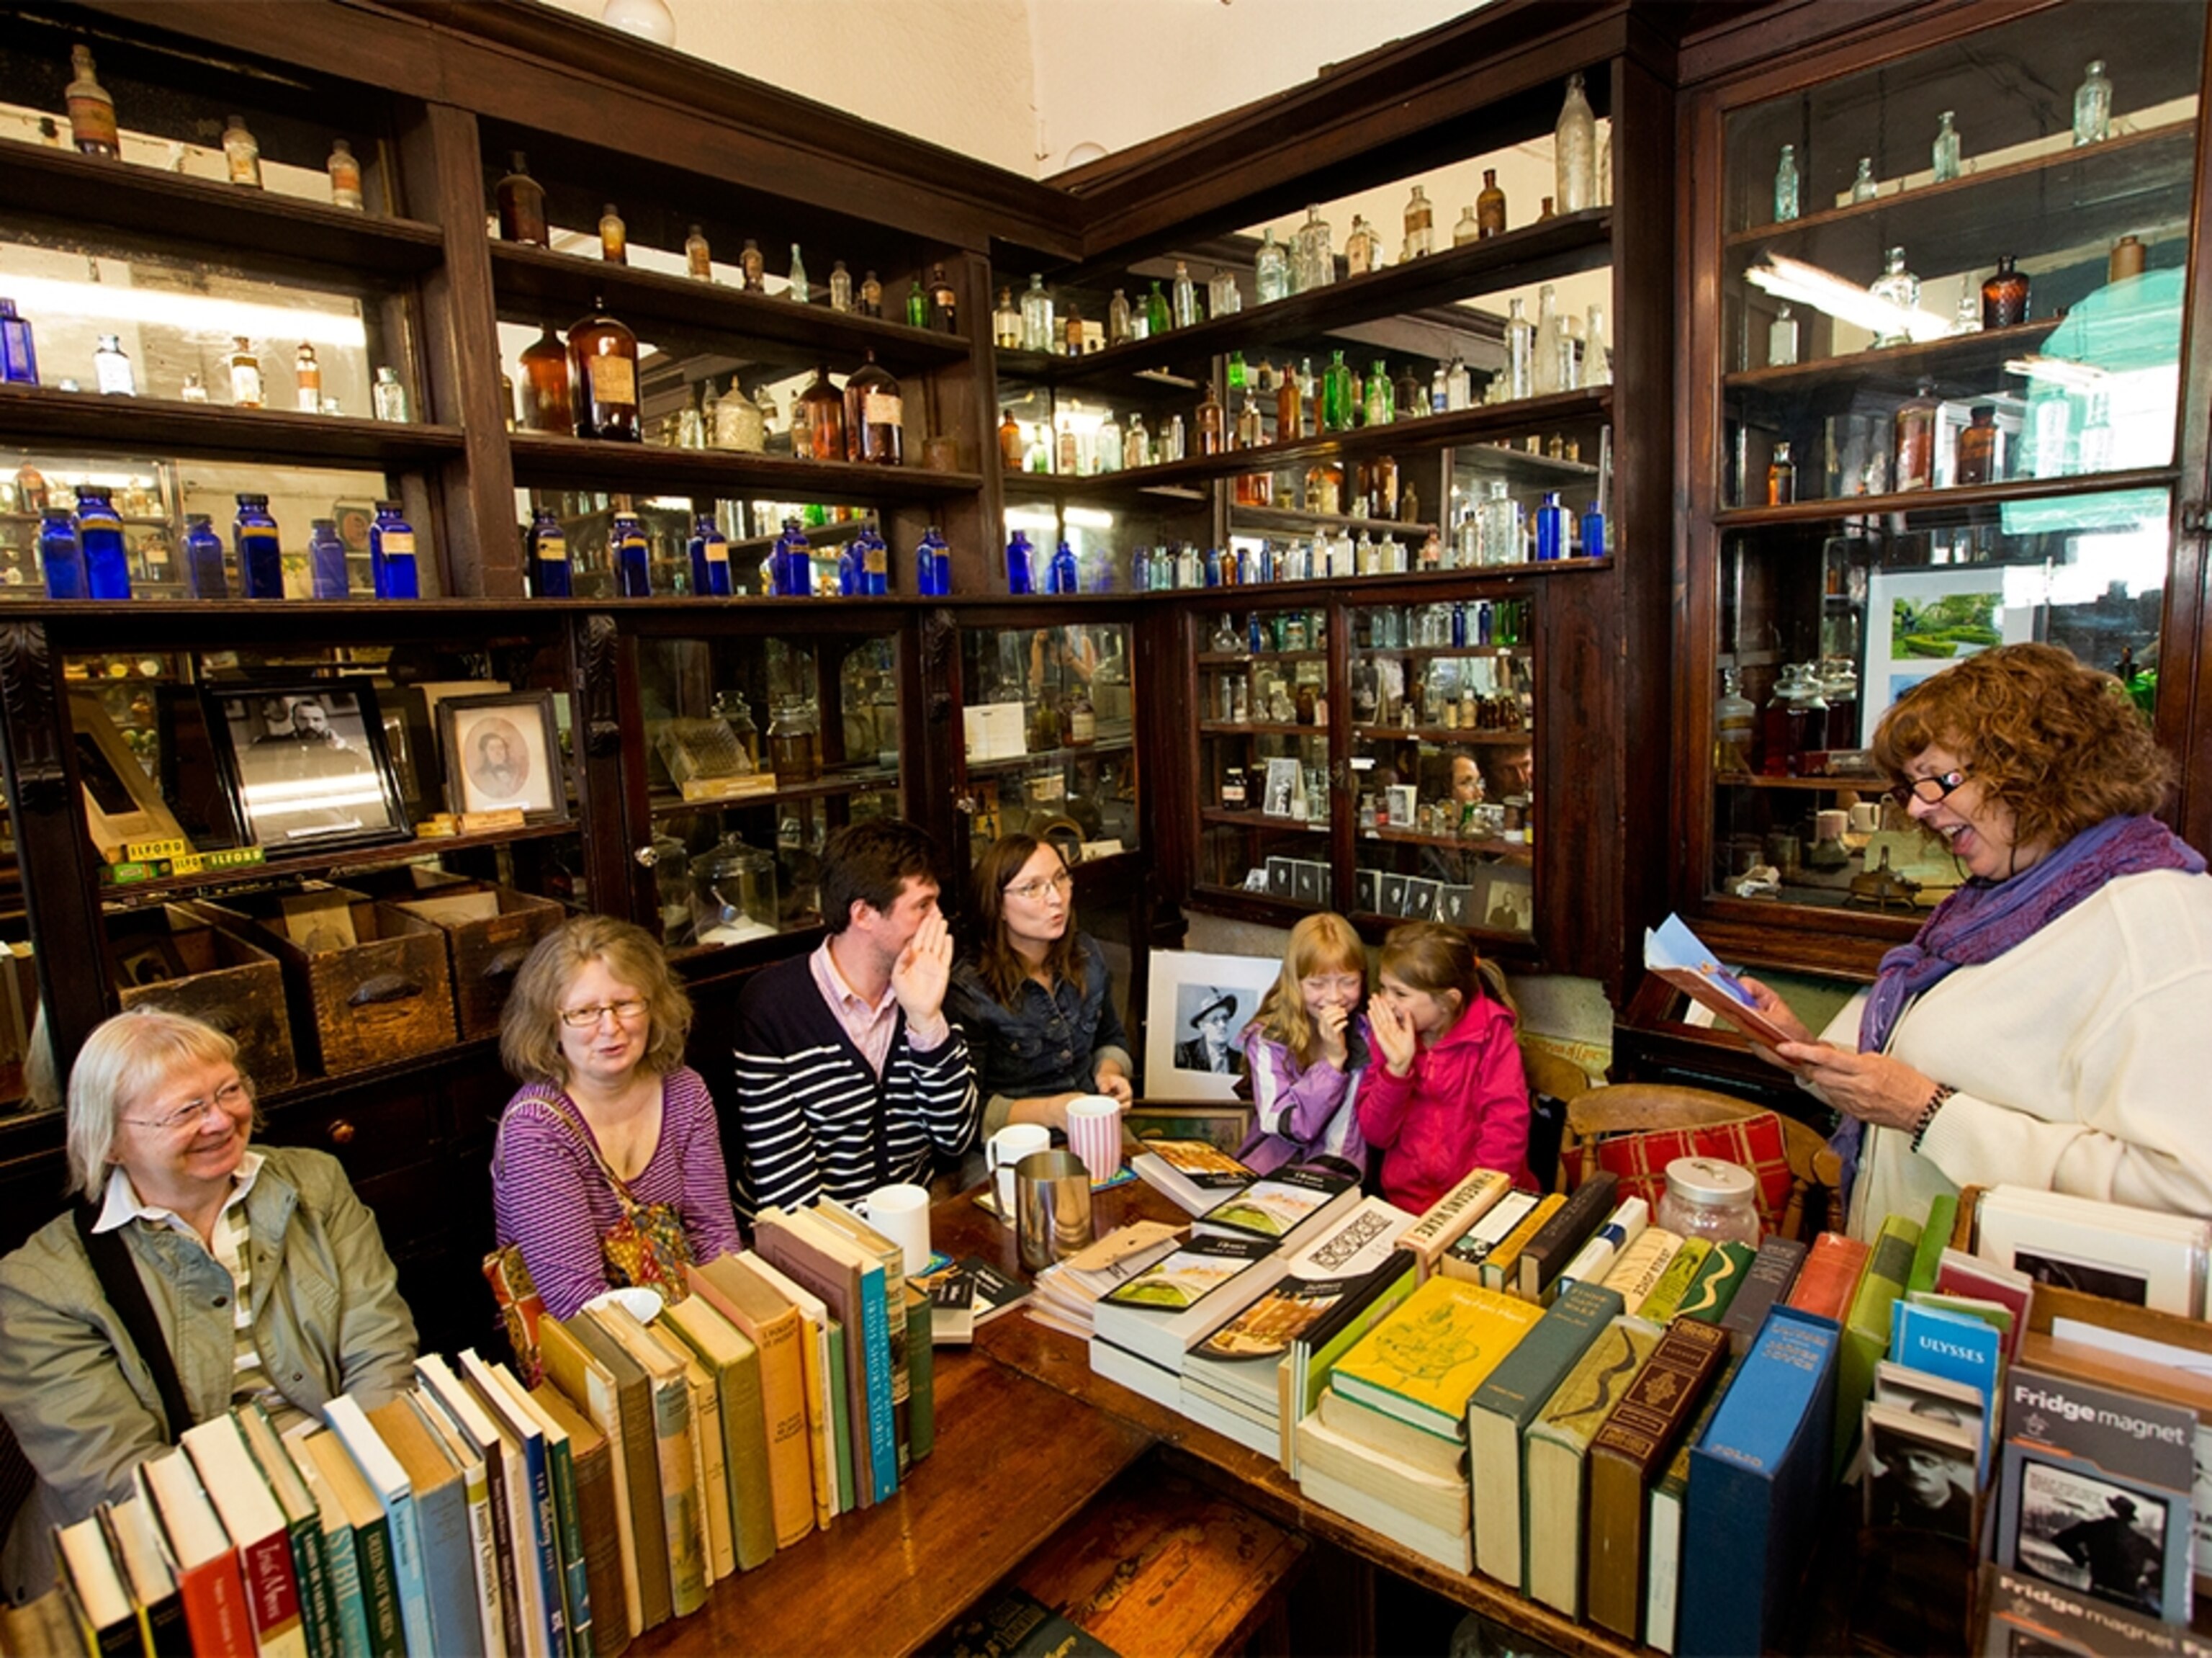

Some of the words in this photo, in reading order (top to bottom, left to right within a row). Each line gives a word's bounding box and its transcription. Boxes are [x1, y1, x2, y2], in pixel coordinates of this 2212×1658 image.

[130, 842, 182, 856] ILFORD
[211, 851, 262, 865] ILFORD
[1413, 1210, 1455, 1240] WAKE
[866, 1299, 878, 1344] IRISH
[869, 1345, 881, 1391] SHORT
[1919, 1335, 1985, 1363] ULYSSES
[871, 1395, 886, 1456] STORIES
[2015, 1385, 2096, 1422] Fridge
[2098, 1410, 2185, 1446] magnet
[475, 1502, 492, 1543] Family
[328, 1528, 361, 1610] SYBIL
[367, 1530, 385, 1571] DEEDS
[374, 1568, 390, 1597] NOT
[480, 1543, 498, 1608] Chronicles
[2000, 1574, 2084, 1617] Fridge
[2085, 1608, 2175, 1651] magnet
